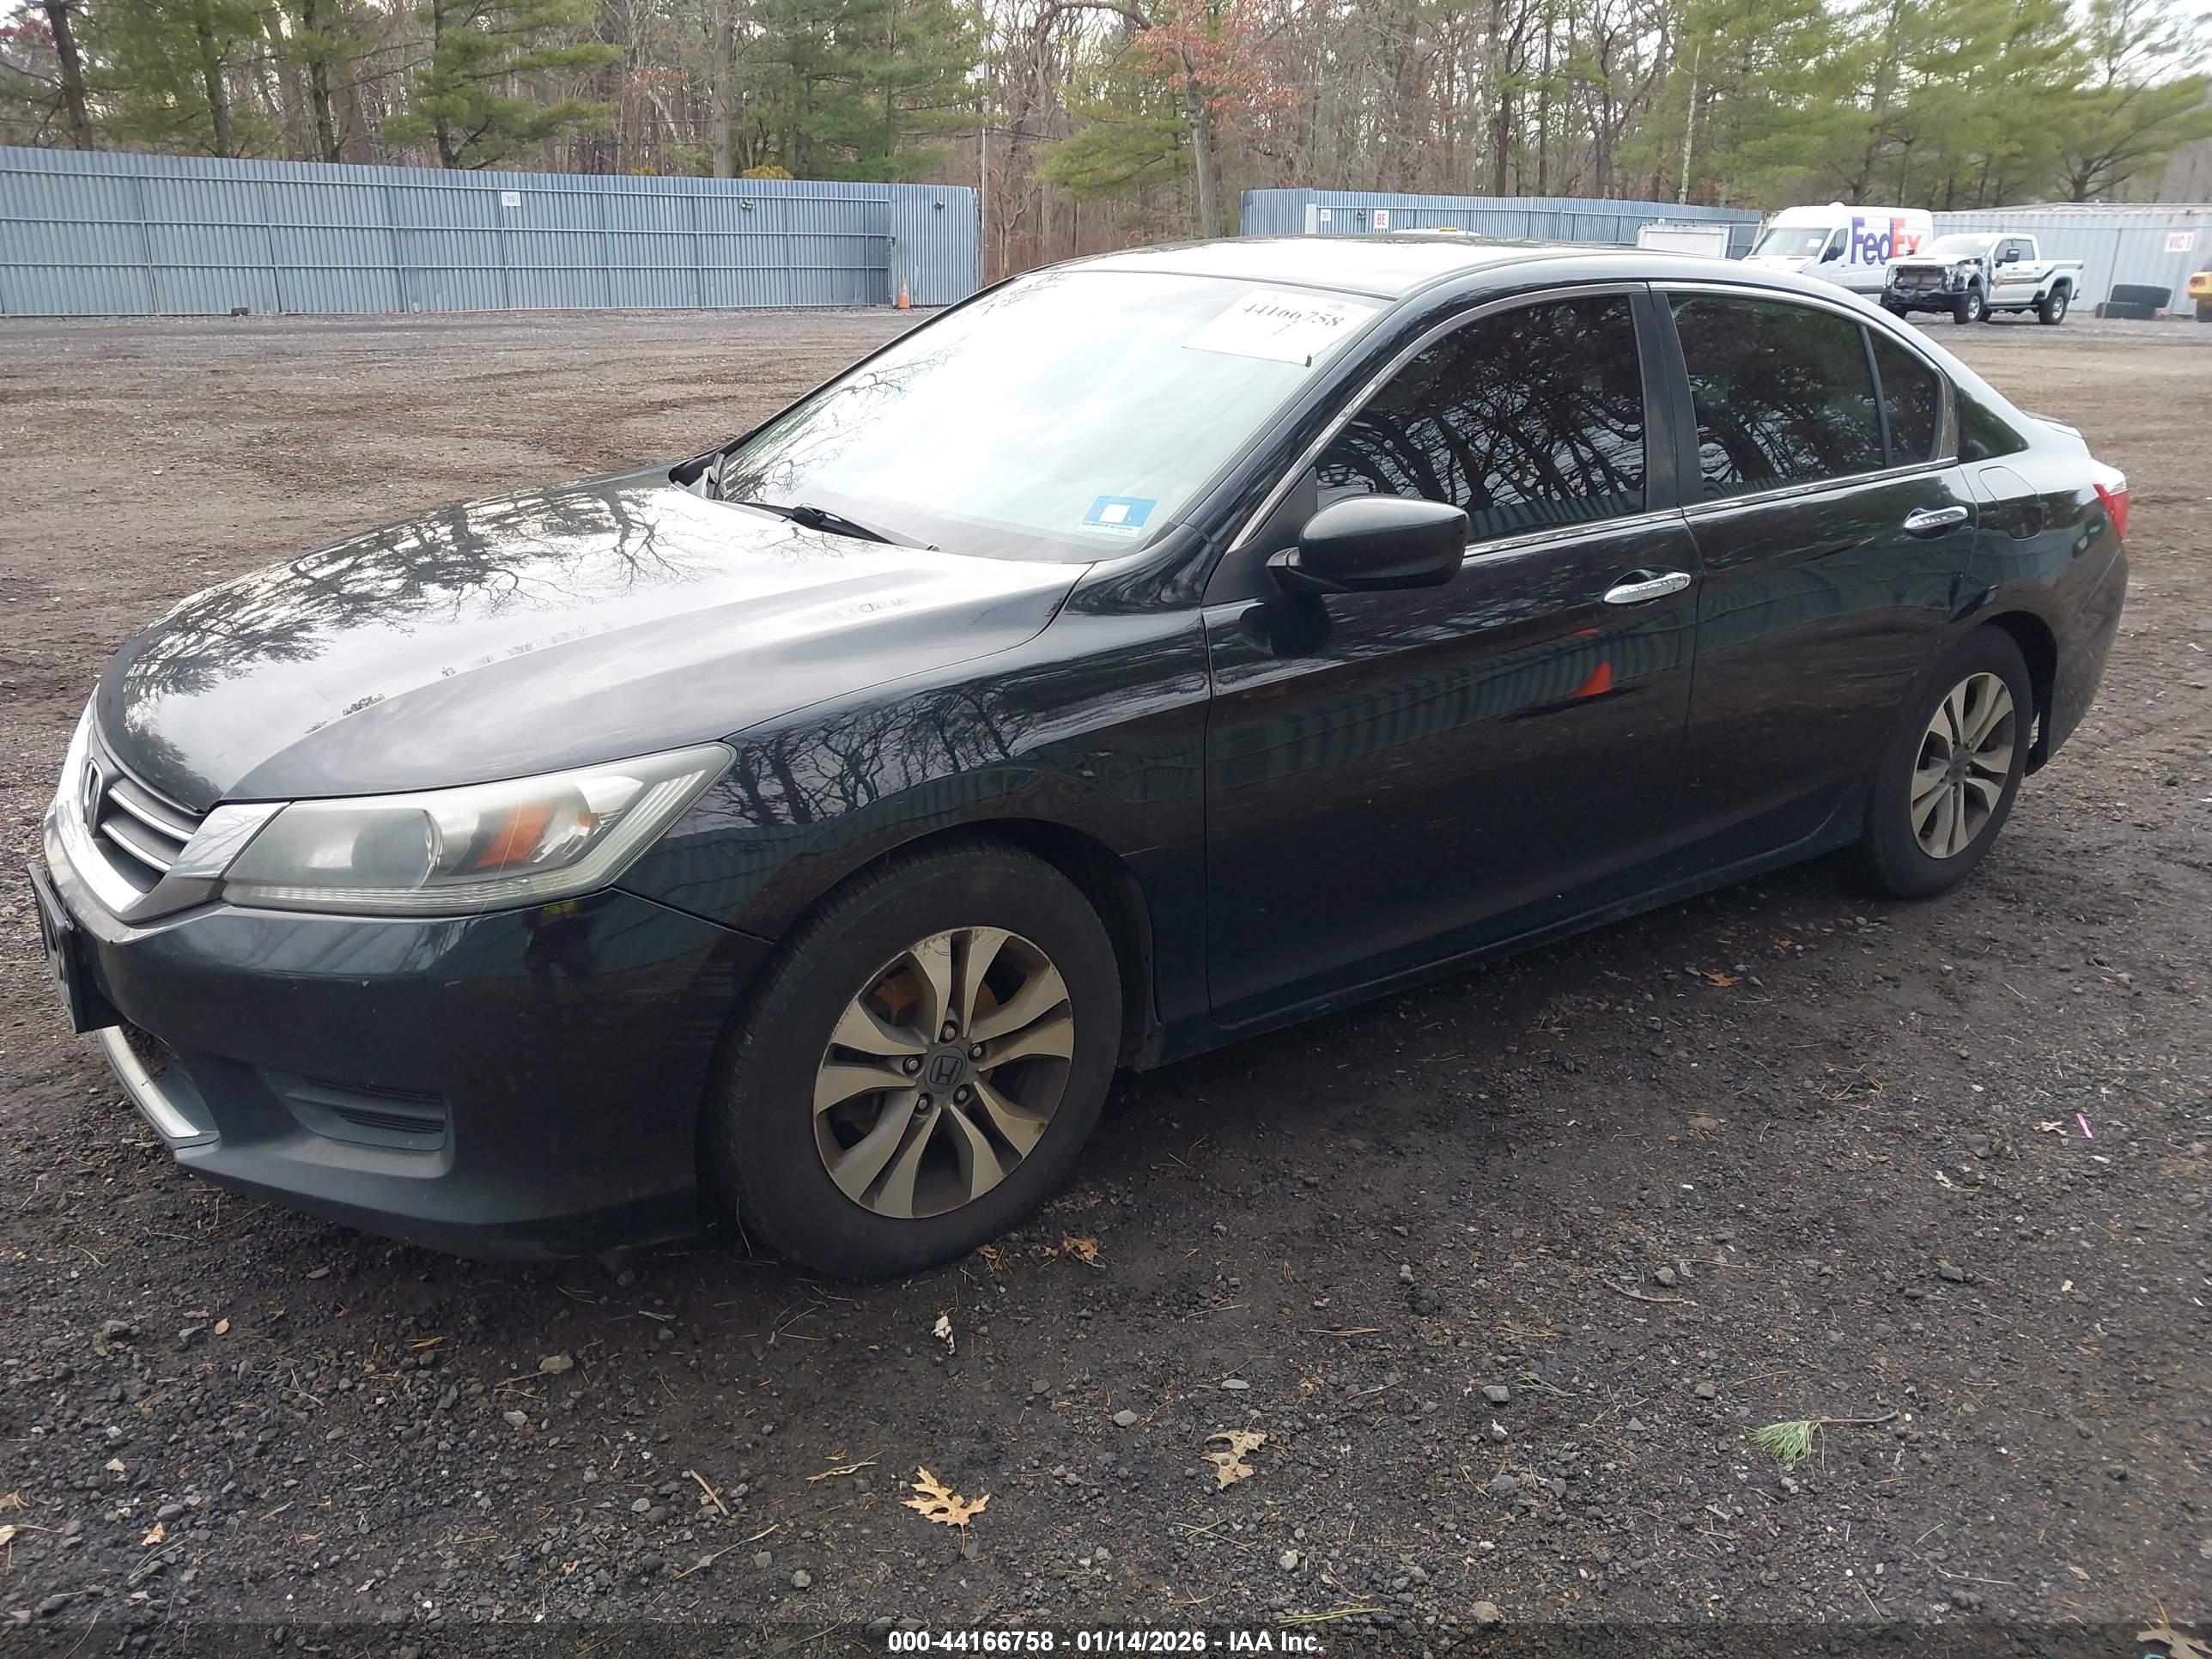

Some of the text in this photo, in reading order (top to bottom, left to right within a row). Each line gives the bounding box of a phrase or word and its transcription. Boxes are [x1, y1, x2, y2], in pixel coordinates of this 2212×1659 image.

[1376, 213, 1386, 225] BE
[1850, 216, 1922, 265] FedEx
[2169, 235, 2185, 248] VIC
